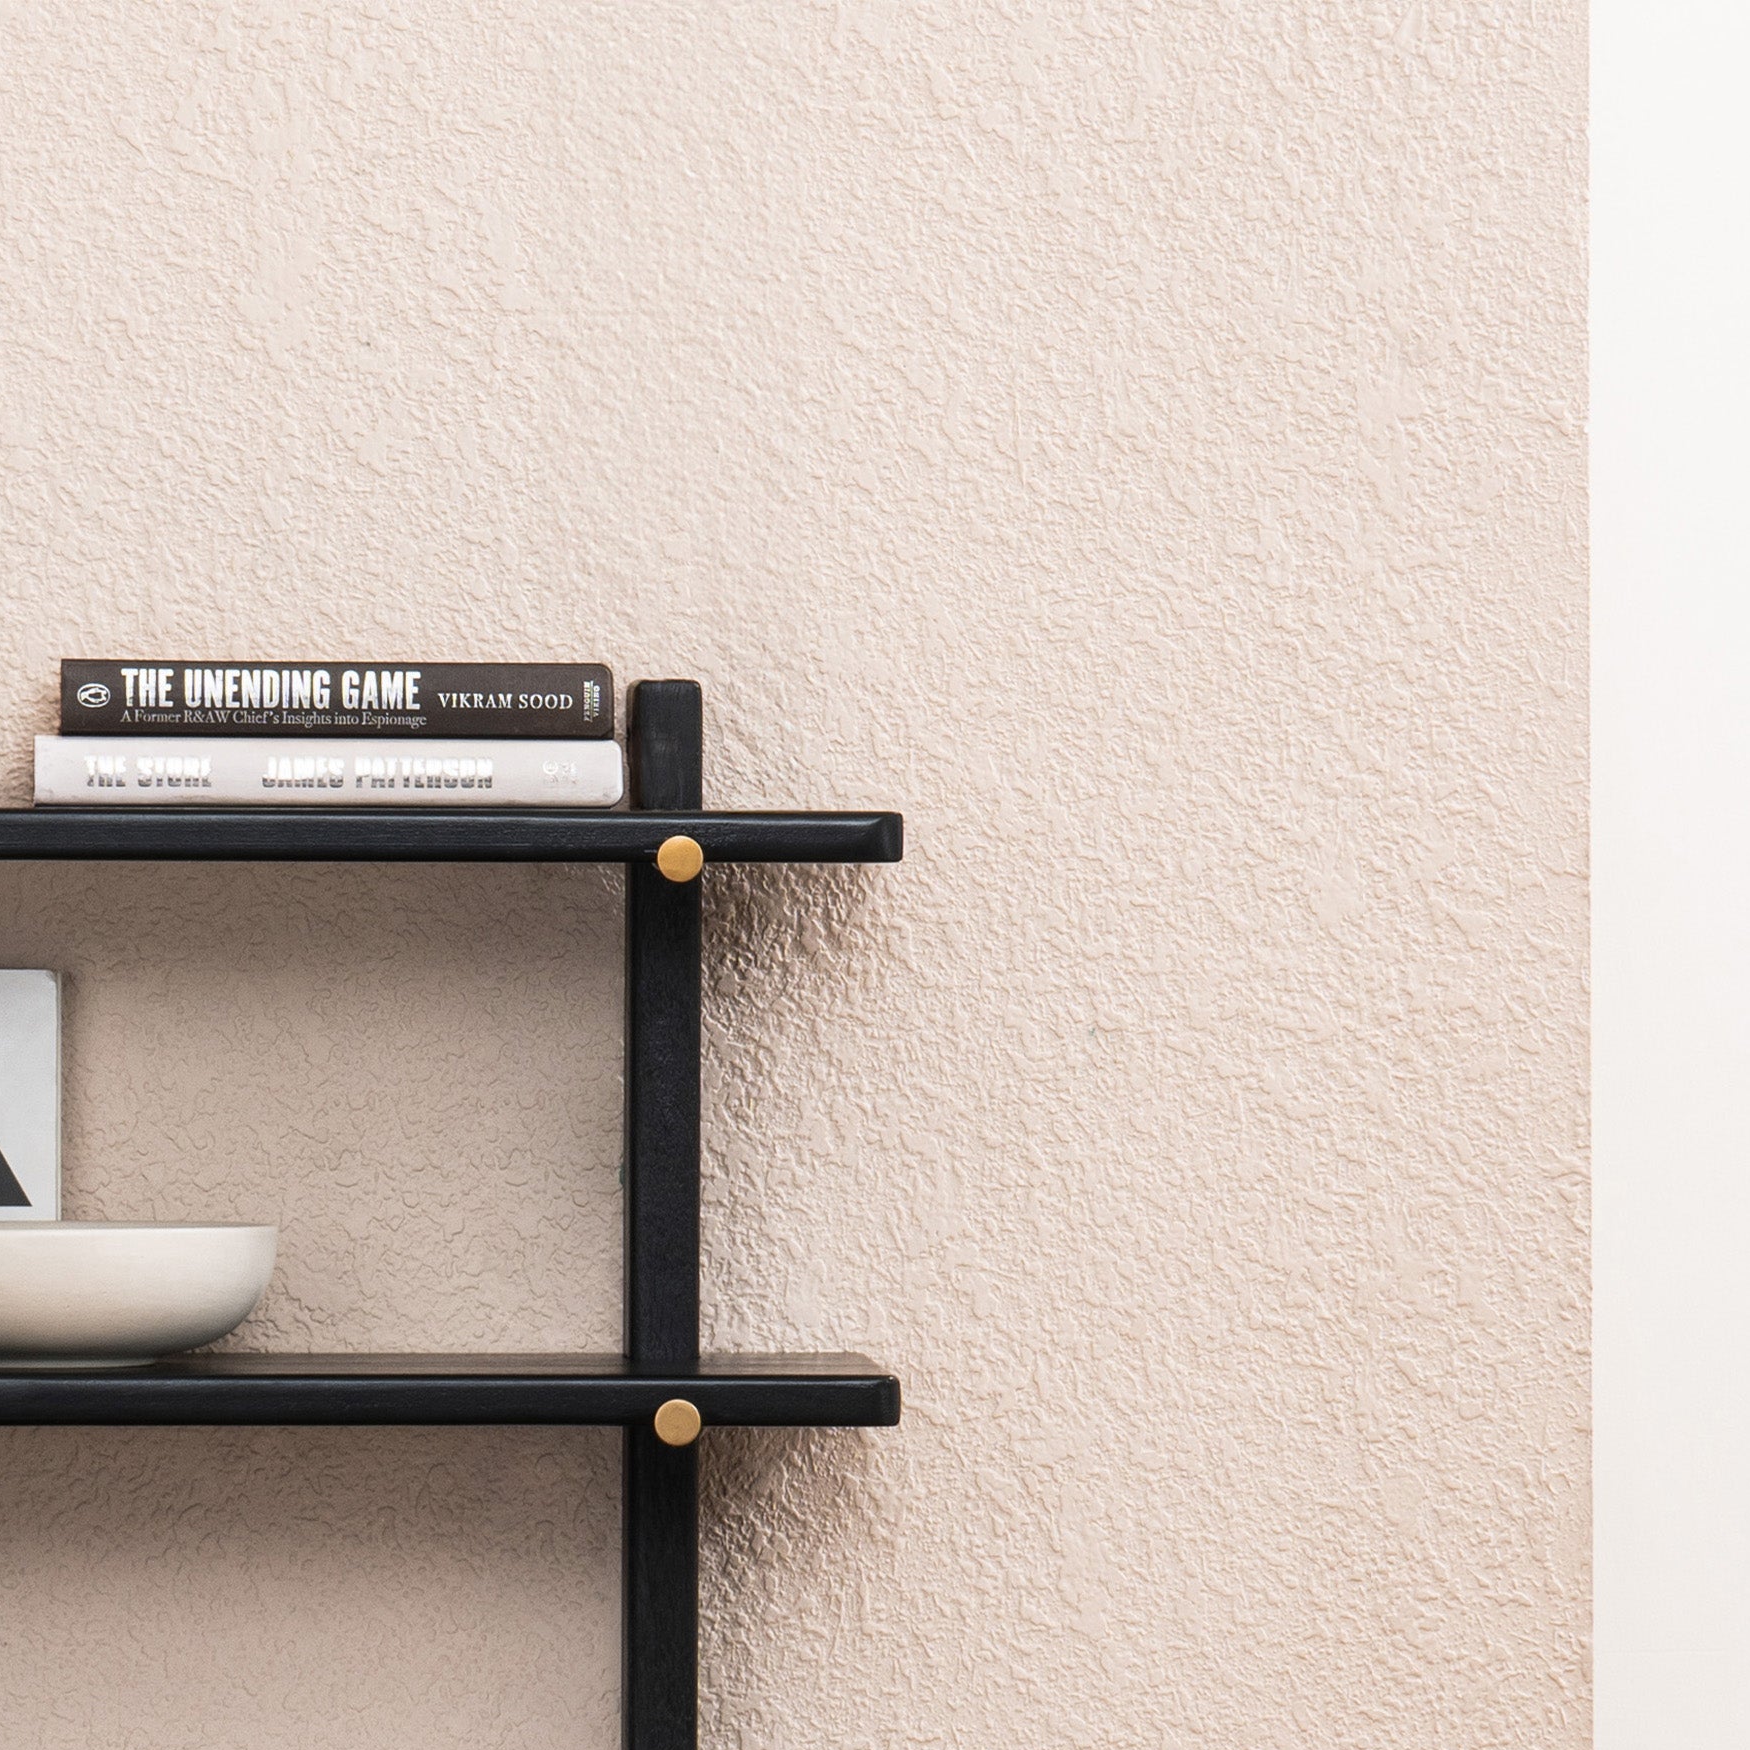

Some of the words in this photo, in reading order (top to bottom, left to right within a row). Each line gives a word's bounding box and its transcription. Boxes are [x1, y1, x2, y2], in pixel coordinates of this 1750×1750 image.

[121, 668, 175, 708] THE
[184, 668, 331, 709] UNENDING
[341, 670, 422, 711] GAME
[438, 692, 512, 709] VIKRAM
[519, 693, 573, 710] SOOD
[593, 685, 601, 717] VIKING
[120, 711, 131, 723] A
[135, 710, 181, 723] Former
[184, 710, 231, 724] R&AW
[233, 710, 280, 725] Chief's
[282, 711, 332, 728] Insights
[335, 712, 359, 725] into
[362, 712, 427, 729] Espionage
[84, 755, 126, 787] THE
[262, 756, 345, 788] JAMES
[355, 757, 493, 788] PATTERSON
